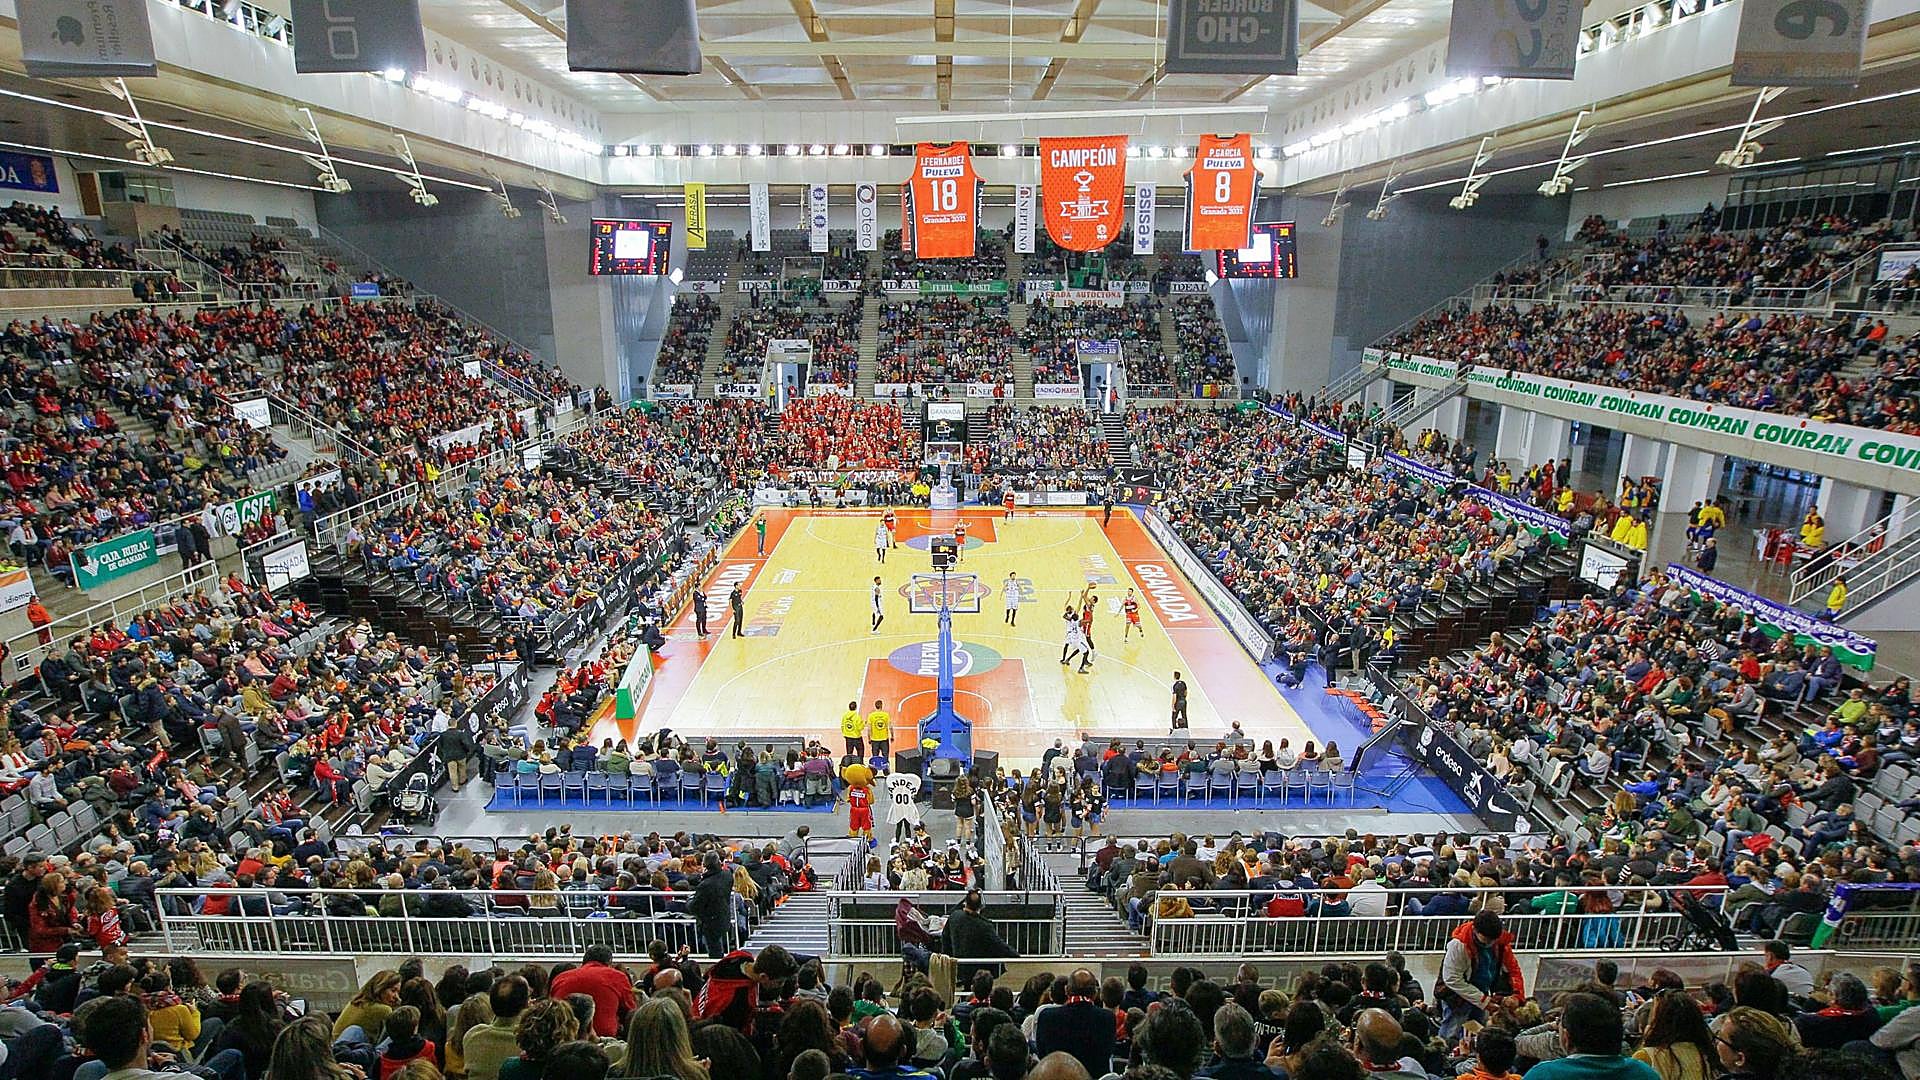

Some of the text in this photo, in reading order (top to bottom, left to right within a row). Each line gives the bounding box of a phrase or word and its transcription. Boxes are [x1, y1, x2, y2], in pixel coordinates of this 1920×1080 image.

[1051, 144, 1117, 168] CAMPEÓN
[1206, 160, 1242, 168] PULEVA
[925, 168, 961, 177] PULEVA
[931, 179, 958, 211] 18
[1215, 171, 1231, 203] 8
[1019, 200, 1028, 250] NEPTUNO
[1138, 188, 1152, 235] asisa
[861, 207, 875, 248] otero
[1172, 284, 1207, 293] IDEAL
[1388, 358, 1455, 379] COVIRAN COVIRAN
[1467, 372, 1495, 384] COVIRAN
[1495, 378, 1541, 396] COVIRAN
[1544, 385, 1597, 406] COVIRAN
[1600, 395, 1665, 419] COVIRAN
[1668, 407, 1749, 435] COVIRAN
[1753, 423, 1854, 455] COVIRAN
[100, 539, 150, 565] CAJA RURAL
[118, 553, 148, 569] GRANADA
[1135, 564, 1200, 623] GRANADA
[1435, 746, 1463, 777] endesa
[895, 793, 909, 805] 00
